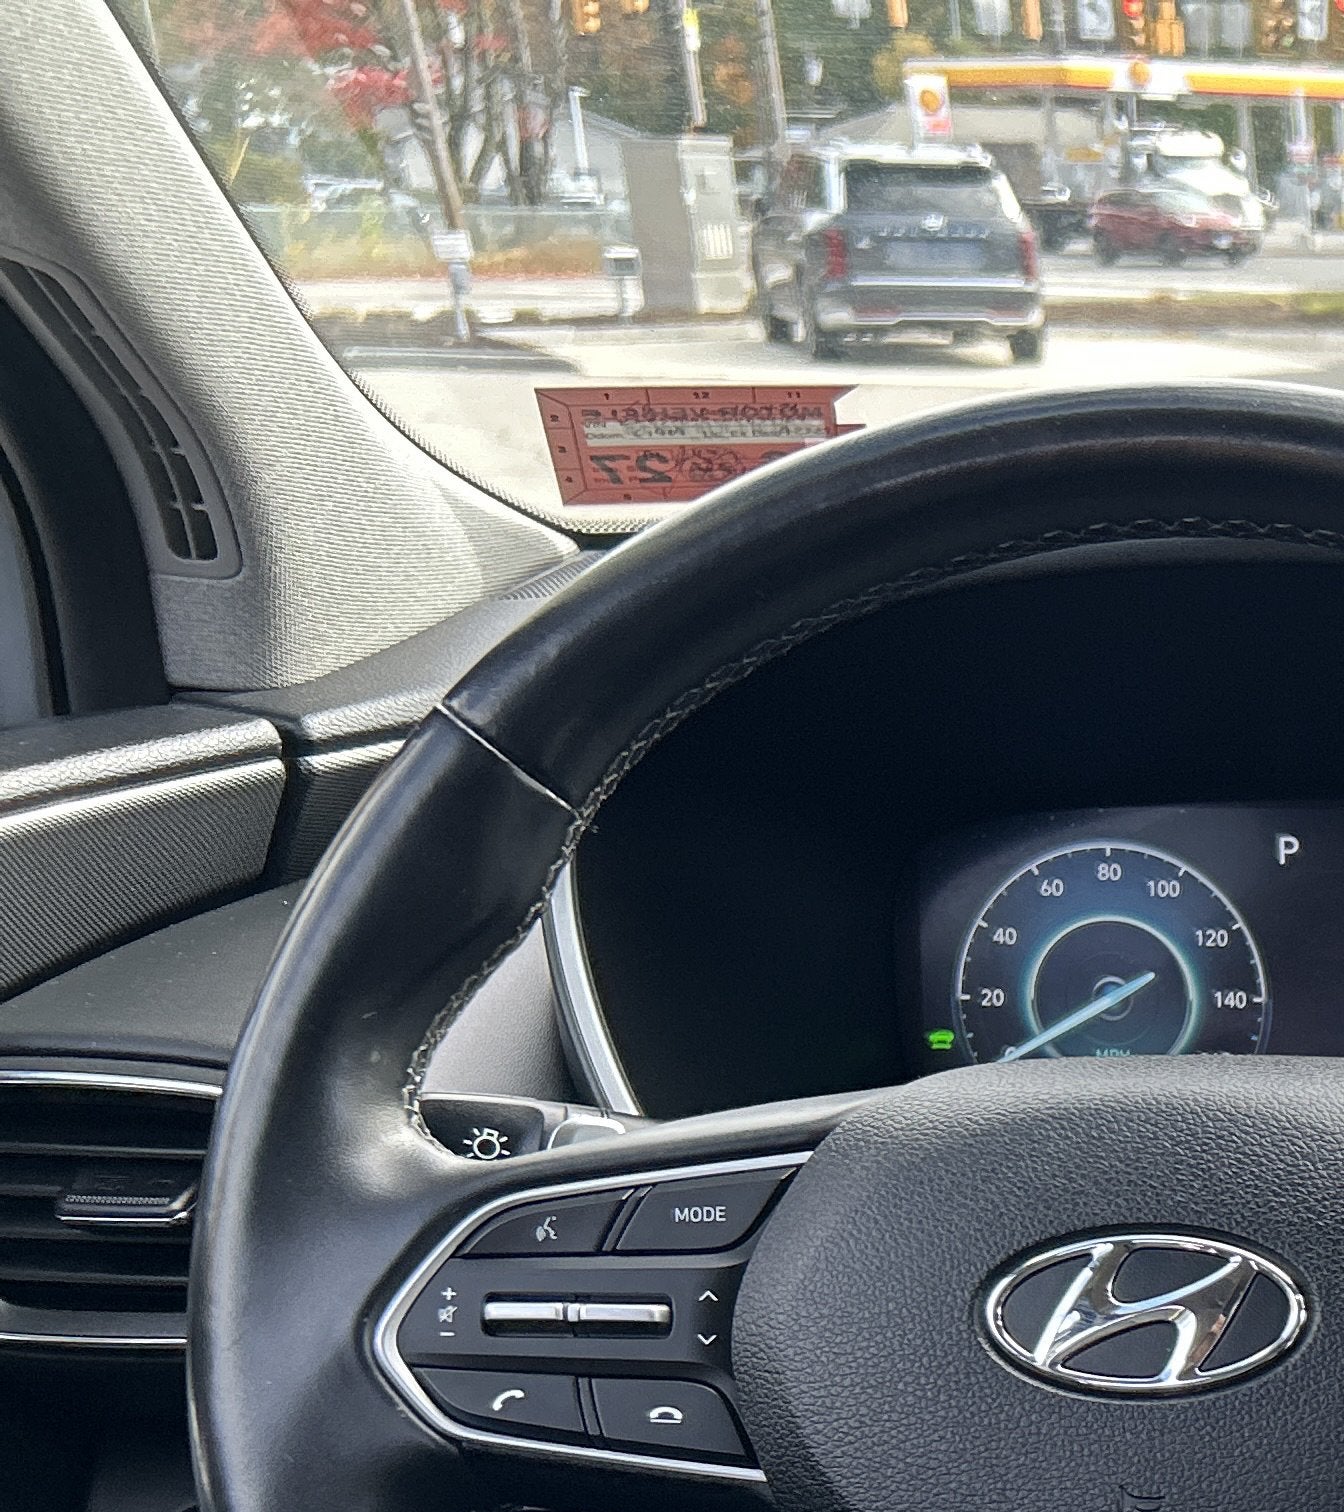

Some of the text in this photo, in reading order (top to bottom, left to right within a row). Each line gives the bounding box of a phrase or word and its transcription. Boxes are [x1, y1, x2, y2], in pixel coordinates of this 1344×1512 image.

[1277, 836, 1300, 865] P
[1097, 864, 1121, 881] 80
[1040, 880, 1064, 897] 60
[1148, 880, 1180, 898] 100
[993, 928, 1017, 944] 40
[1195, 930, 1228, 947] 120
[981, 989, 1004, 1007] 20
[1214, 991, 1246, 1008] 140
[675, 1207, 726, 1222] MODE
